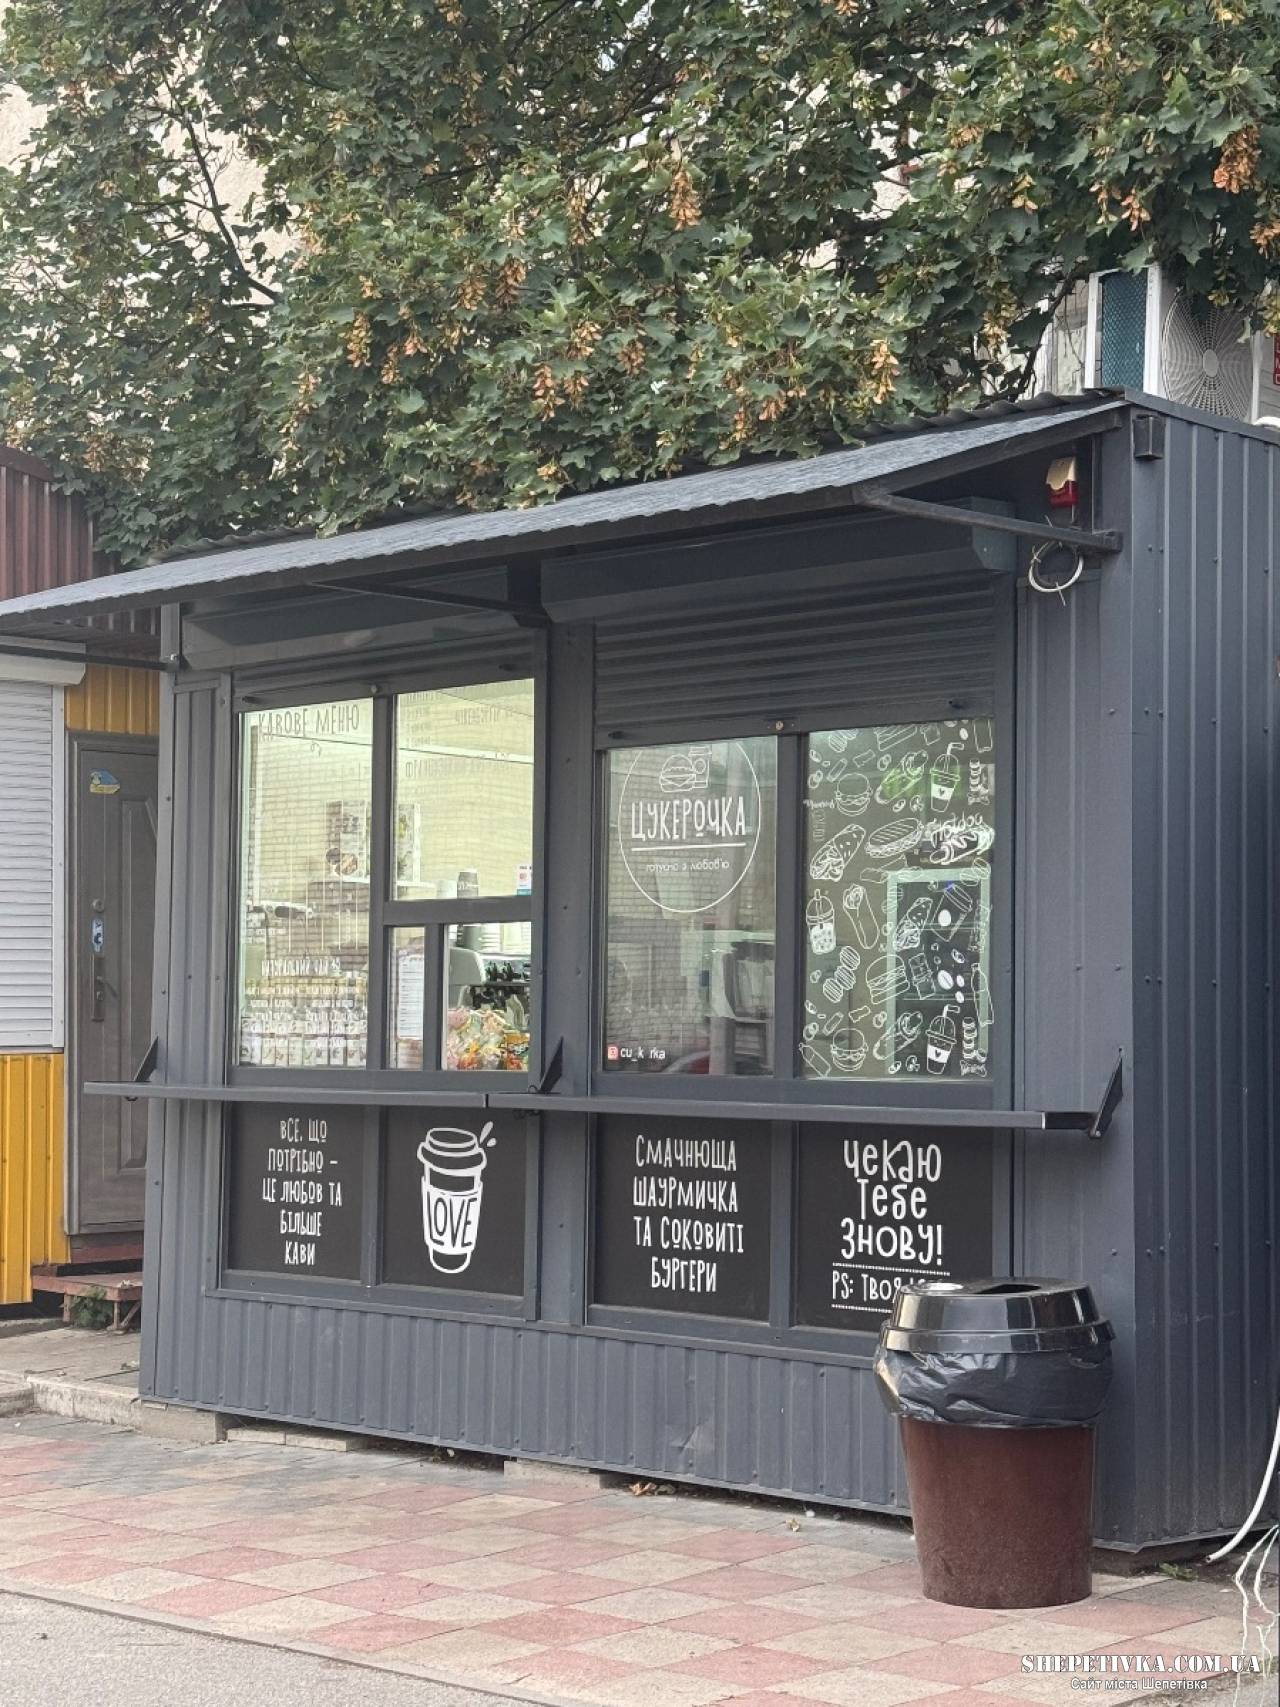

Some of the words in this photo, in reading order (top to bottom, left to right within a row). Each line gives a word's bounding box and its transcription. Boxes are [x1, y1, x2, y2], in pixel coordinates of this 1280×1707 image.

[316, 703, 360, 734] МЕНЮ
[631, 796, 747, 841] ЦУКЕРОЧКА
[308, 1118, 328, 1144] ЩО
[268, 1148, 324, 1173] ПОТРІБНО
[262, 1177, 277, 1203] ЦЕ
[280, 1179, 323, 1205] ЛЮБОВ
[328, 1181, 343, 1207] ТА
[633, 1175, 739, 1213] ШАУРМИЧКА
[279, 1210, 323, 1237] БІЛЬШЕ
[427, 1191, 478, 1248] LOVE
[633, 1216, 652, 1248] ТА
[660, 1215, 745, 1254] СОКОВИТІ
[284, 1240, 316, 1266] КАВИ
[840, 1216, 943, 1266] ЗНОВУ!
[651, 1257, 717, 1293] БУРГЕРИ
[832, 1270, 855, 1300] PS:
